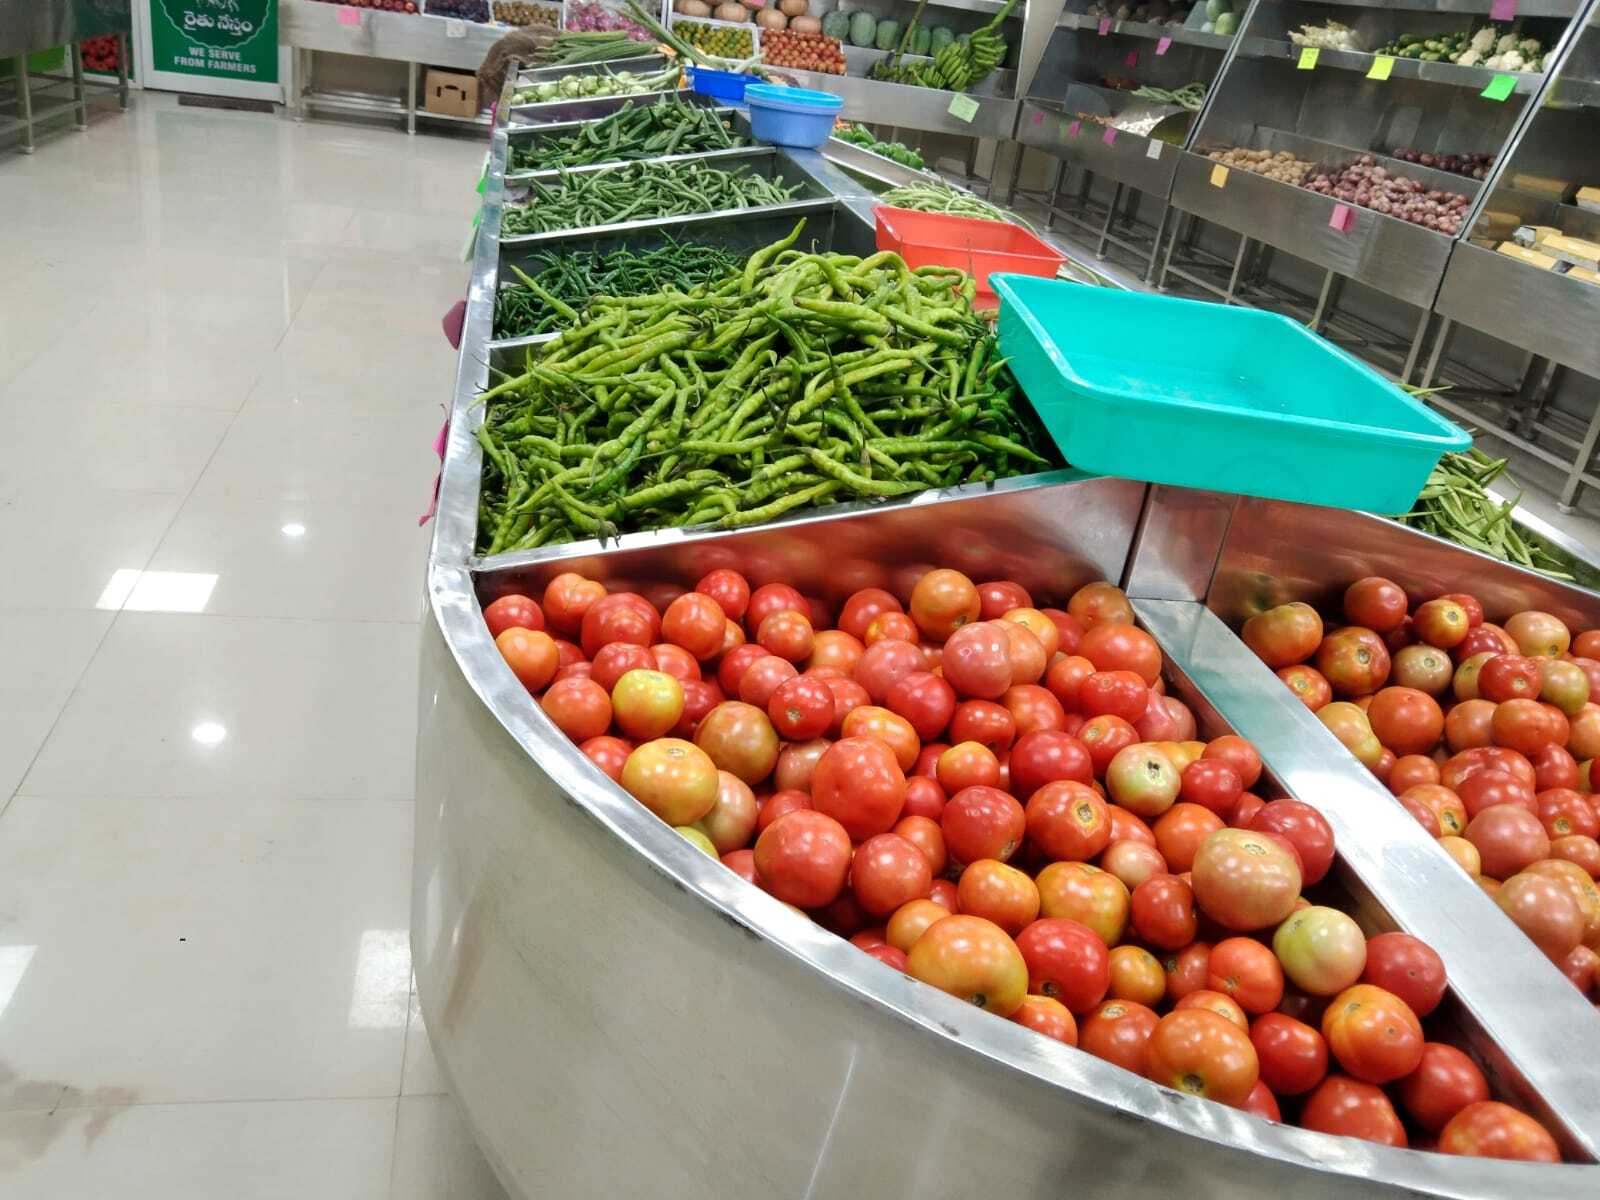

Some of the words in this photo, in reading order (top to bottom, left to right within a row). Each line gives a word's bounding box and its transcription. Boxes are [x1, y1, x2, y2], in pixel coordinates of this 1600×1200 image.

[183, 11, 215, 30] రైతు
[217, 14, 253, 36] నేస్తం
[188, 47, 205, 57] WE
[208, 48, 241, 61] SERVE
[174, 56, 205, 68] FROM
[208, 60, 257, 74] FARMERS
